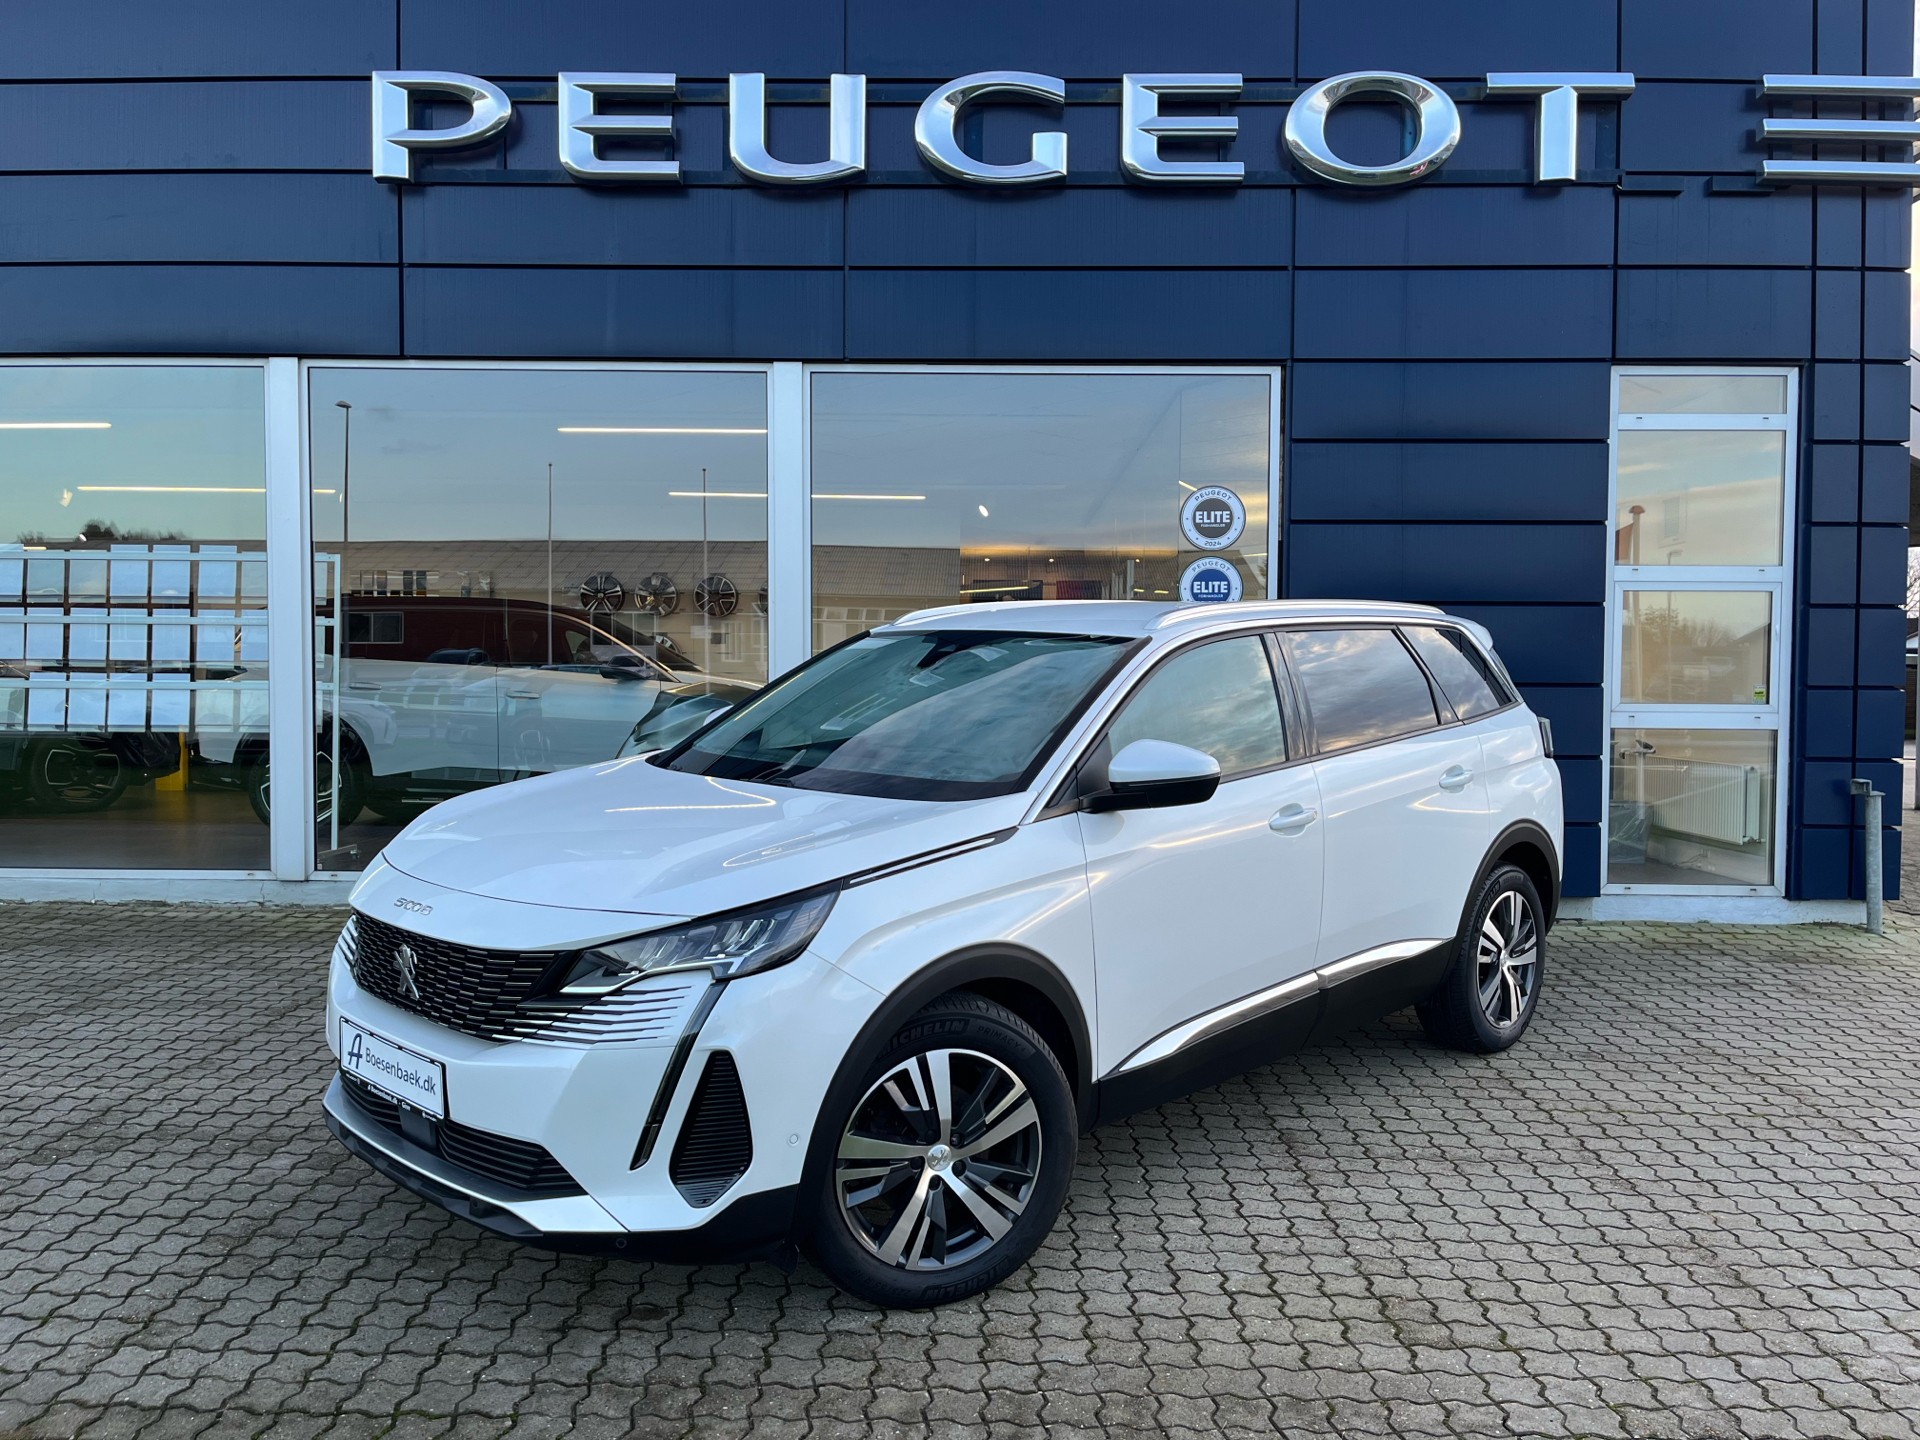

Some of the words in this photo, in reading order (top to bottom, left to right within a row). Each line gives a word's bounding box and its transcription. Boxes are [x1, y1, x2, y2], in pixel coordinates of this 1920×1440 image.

[371, 69, 1636, 187] PEUGEOT
[1195, 490, 1232, 501] PEUGEOT
[1195, 511, 1231, 523] ELITE
[1191, 561, 1231, 572] PEUGEOT
[1193, 581, 1228, 593] ELITE
[977, 1025, 1022, 1048] PRIMACY
[365, 1046, 436, 1096] Boesenbaek.dk
